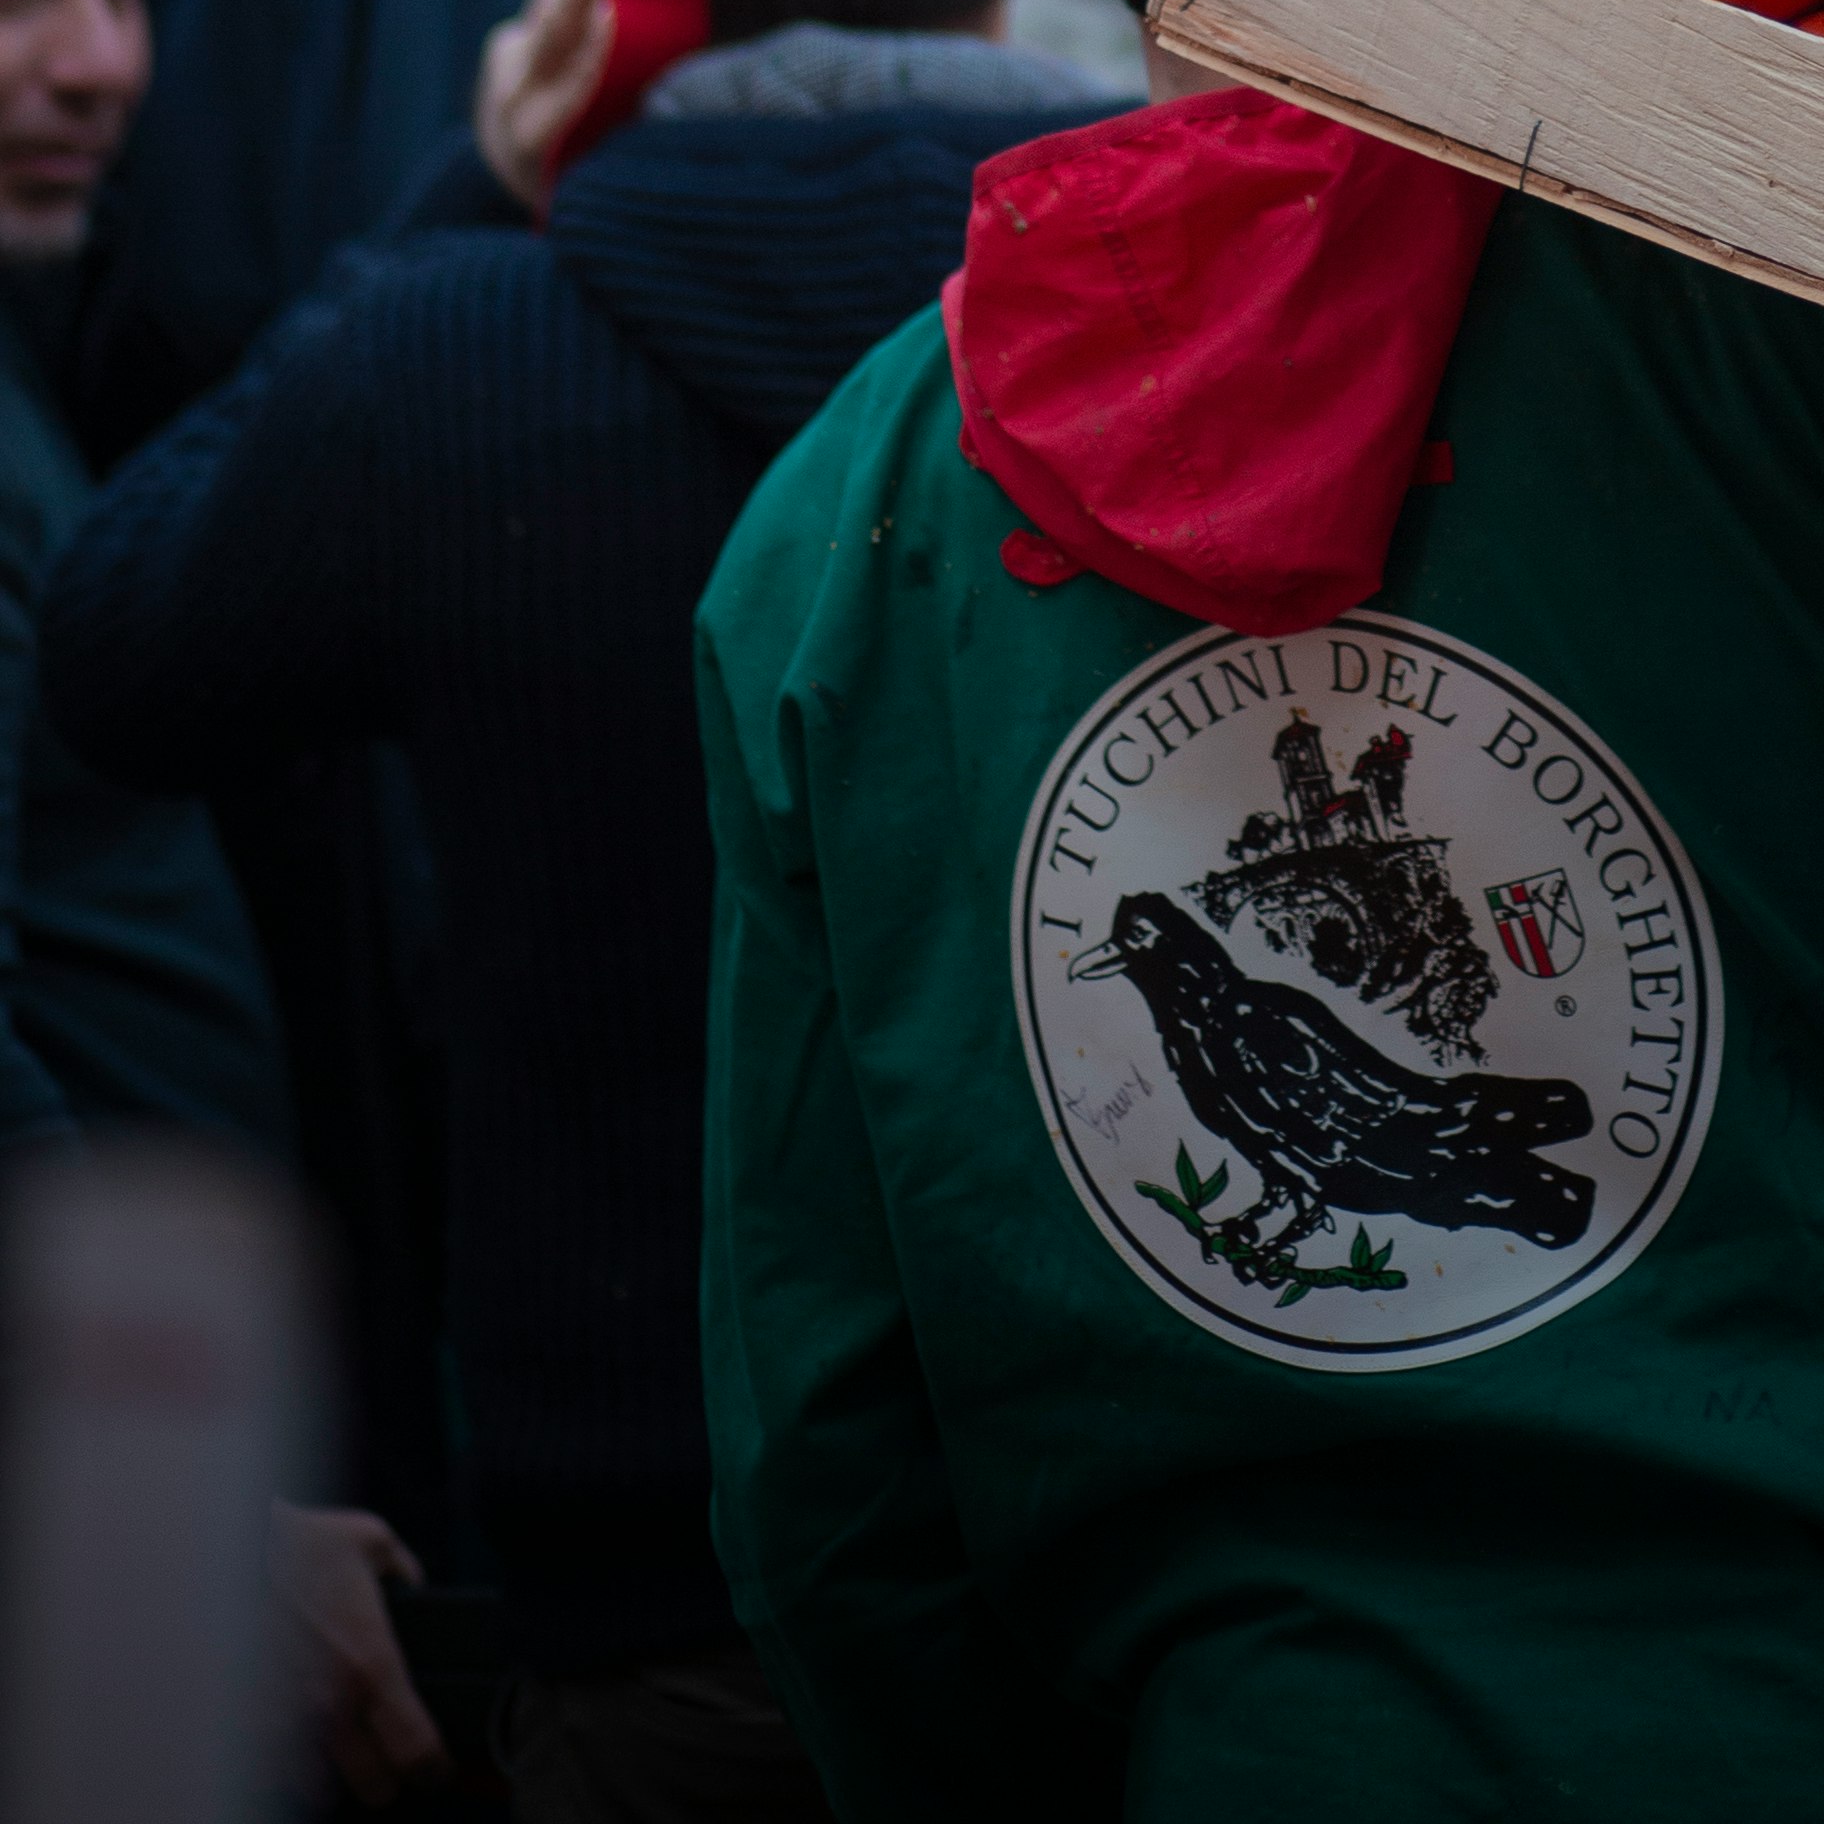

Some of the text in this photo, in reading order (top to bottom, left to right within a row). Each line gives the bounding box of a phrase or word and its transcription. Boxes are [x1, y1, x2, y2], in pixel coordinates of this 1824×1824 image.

[1040, 638, 1688, 1162] I TUCHINI DEL BORGHETTO
